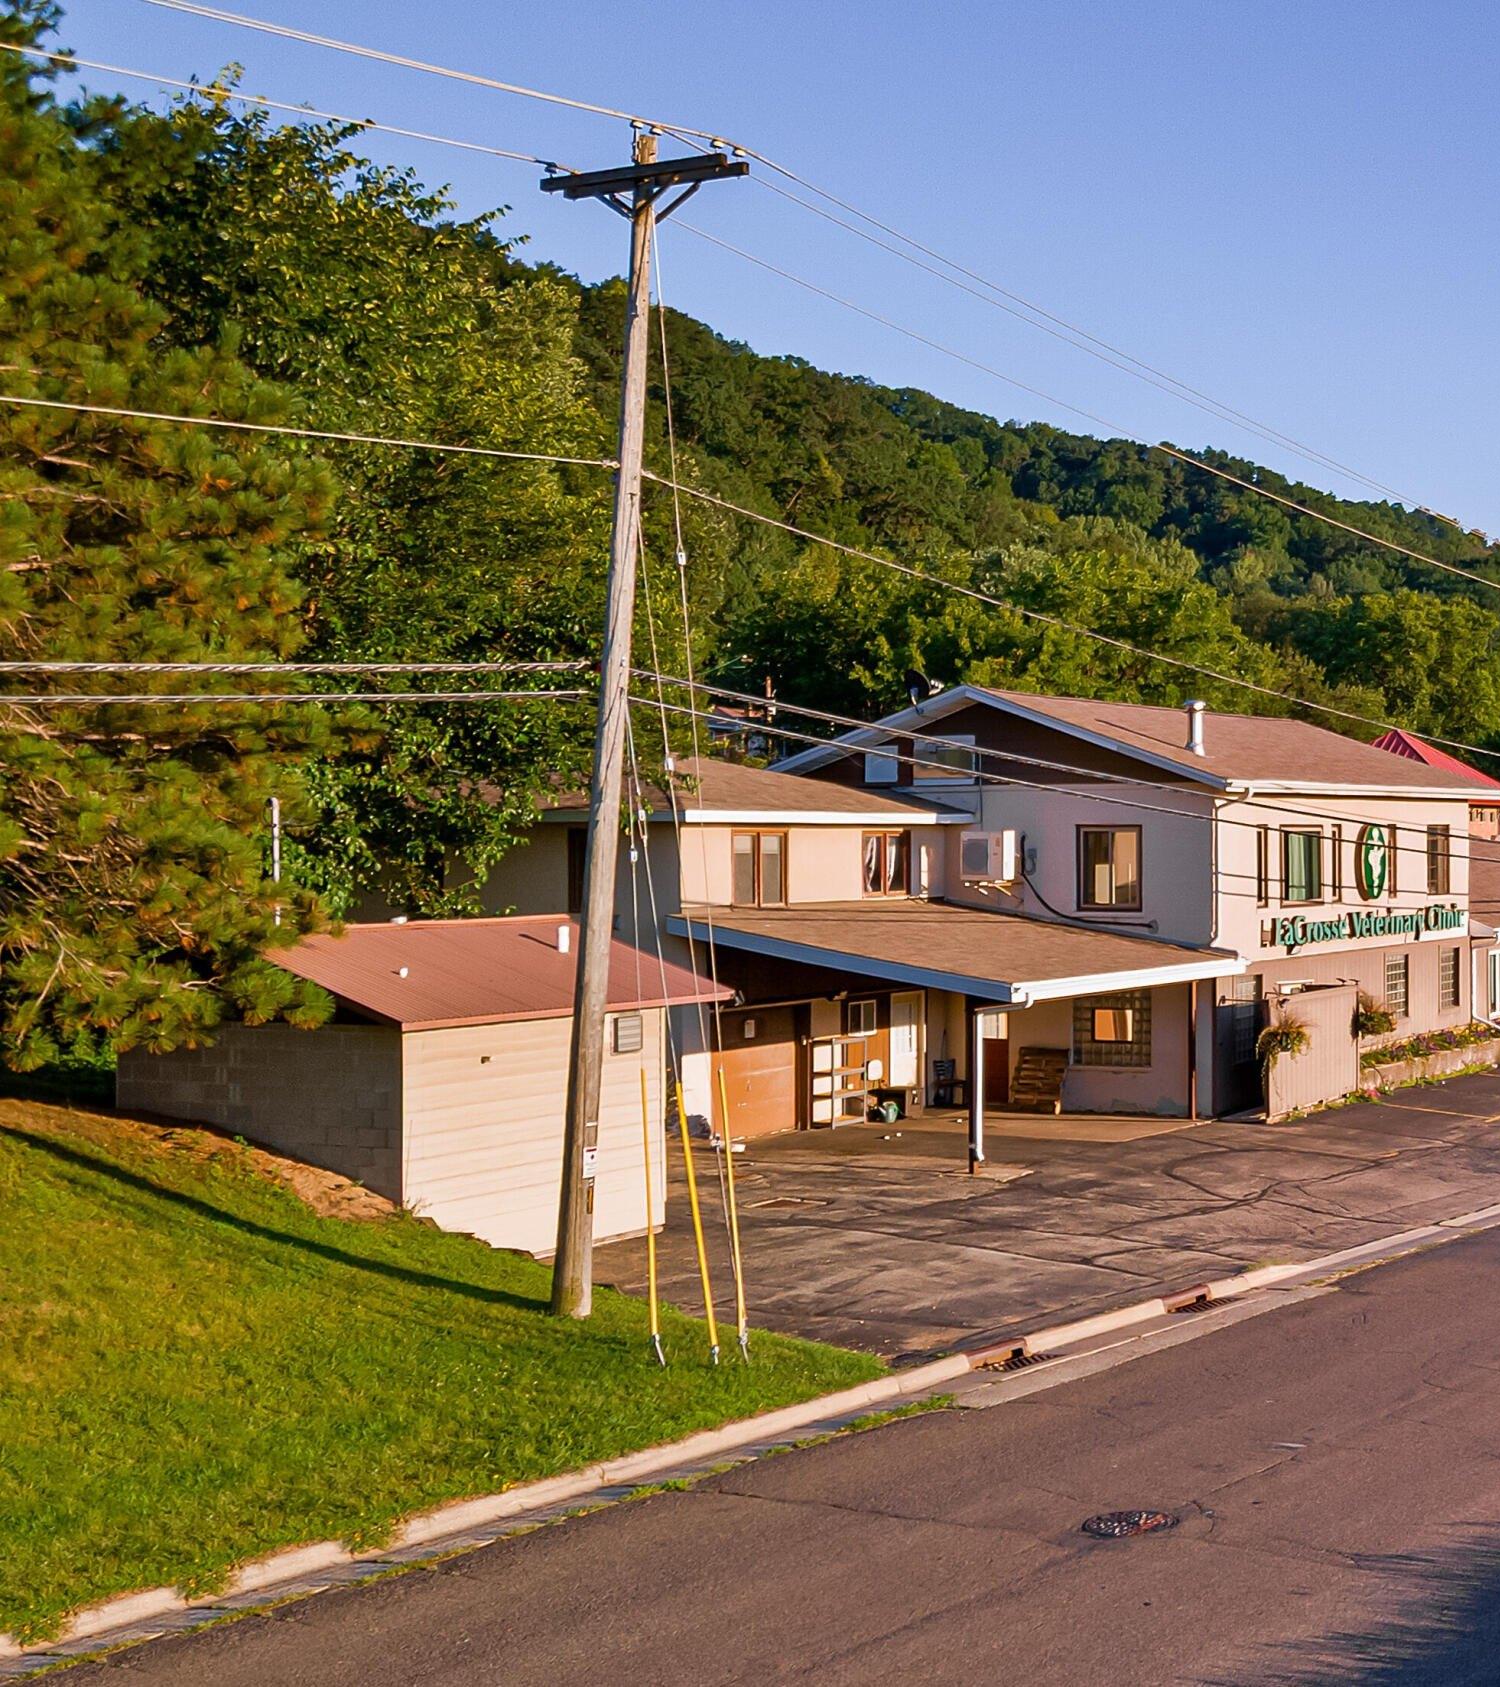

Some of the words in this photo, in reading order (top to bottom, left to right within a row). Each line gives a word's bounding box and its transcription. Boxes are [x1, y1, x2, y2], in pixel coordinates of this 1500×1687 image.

[1276, 915, 1347, 946] LaCrosse
[1352, 907, 1425, 938] Veterinary
[1427, 903, 1465, 931] Clinic
